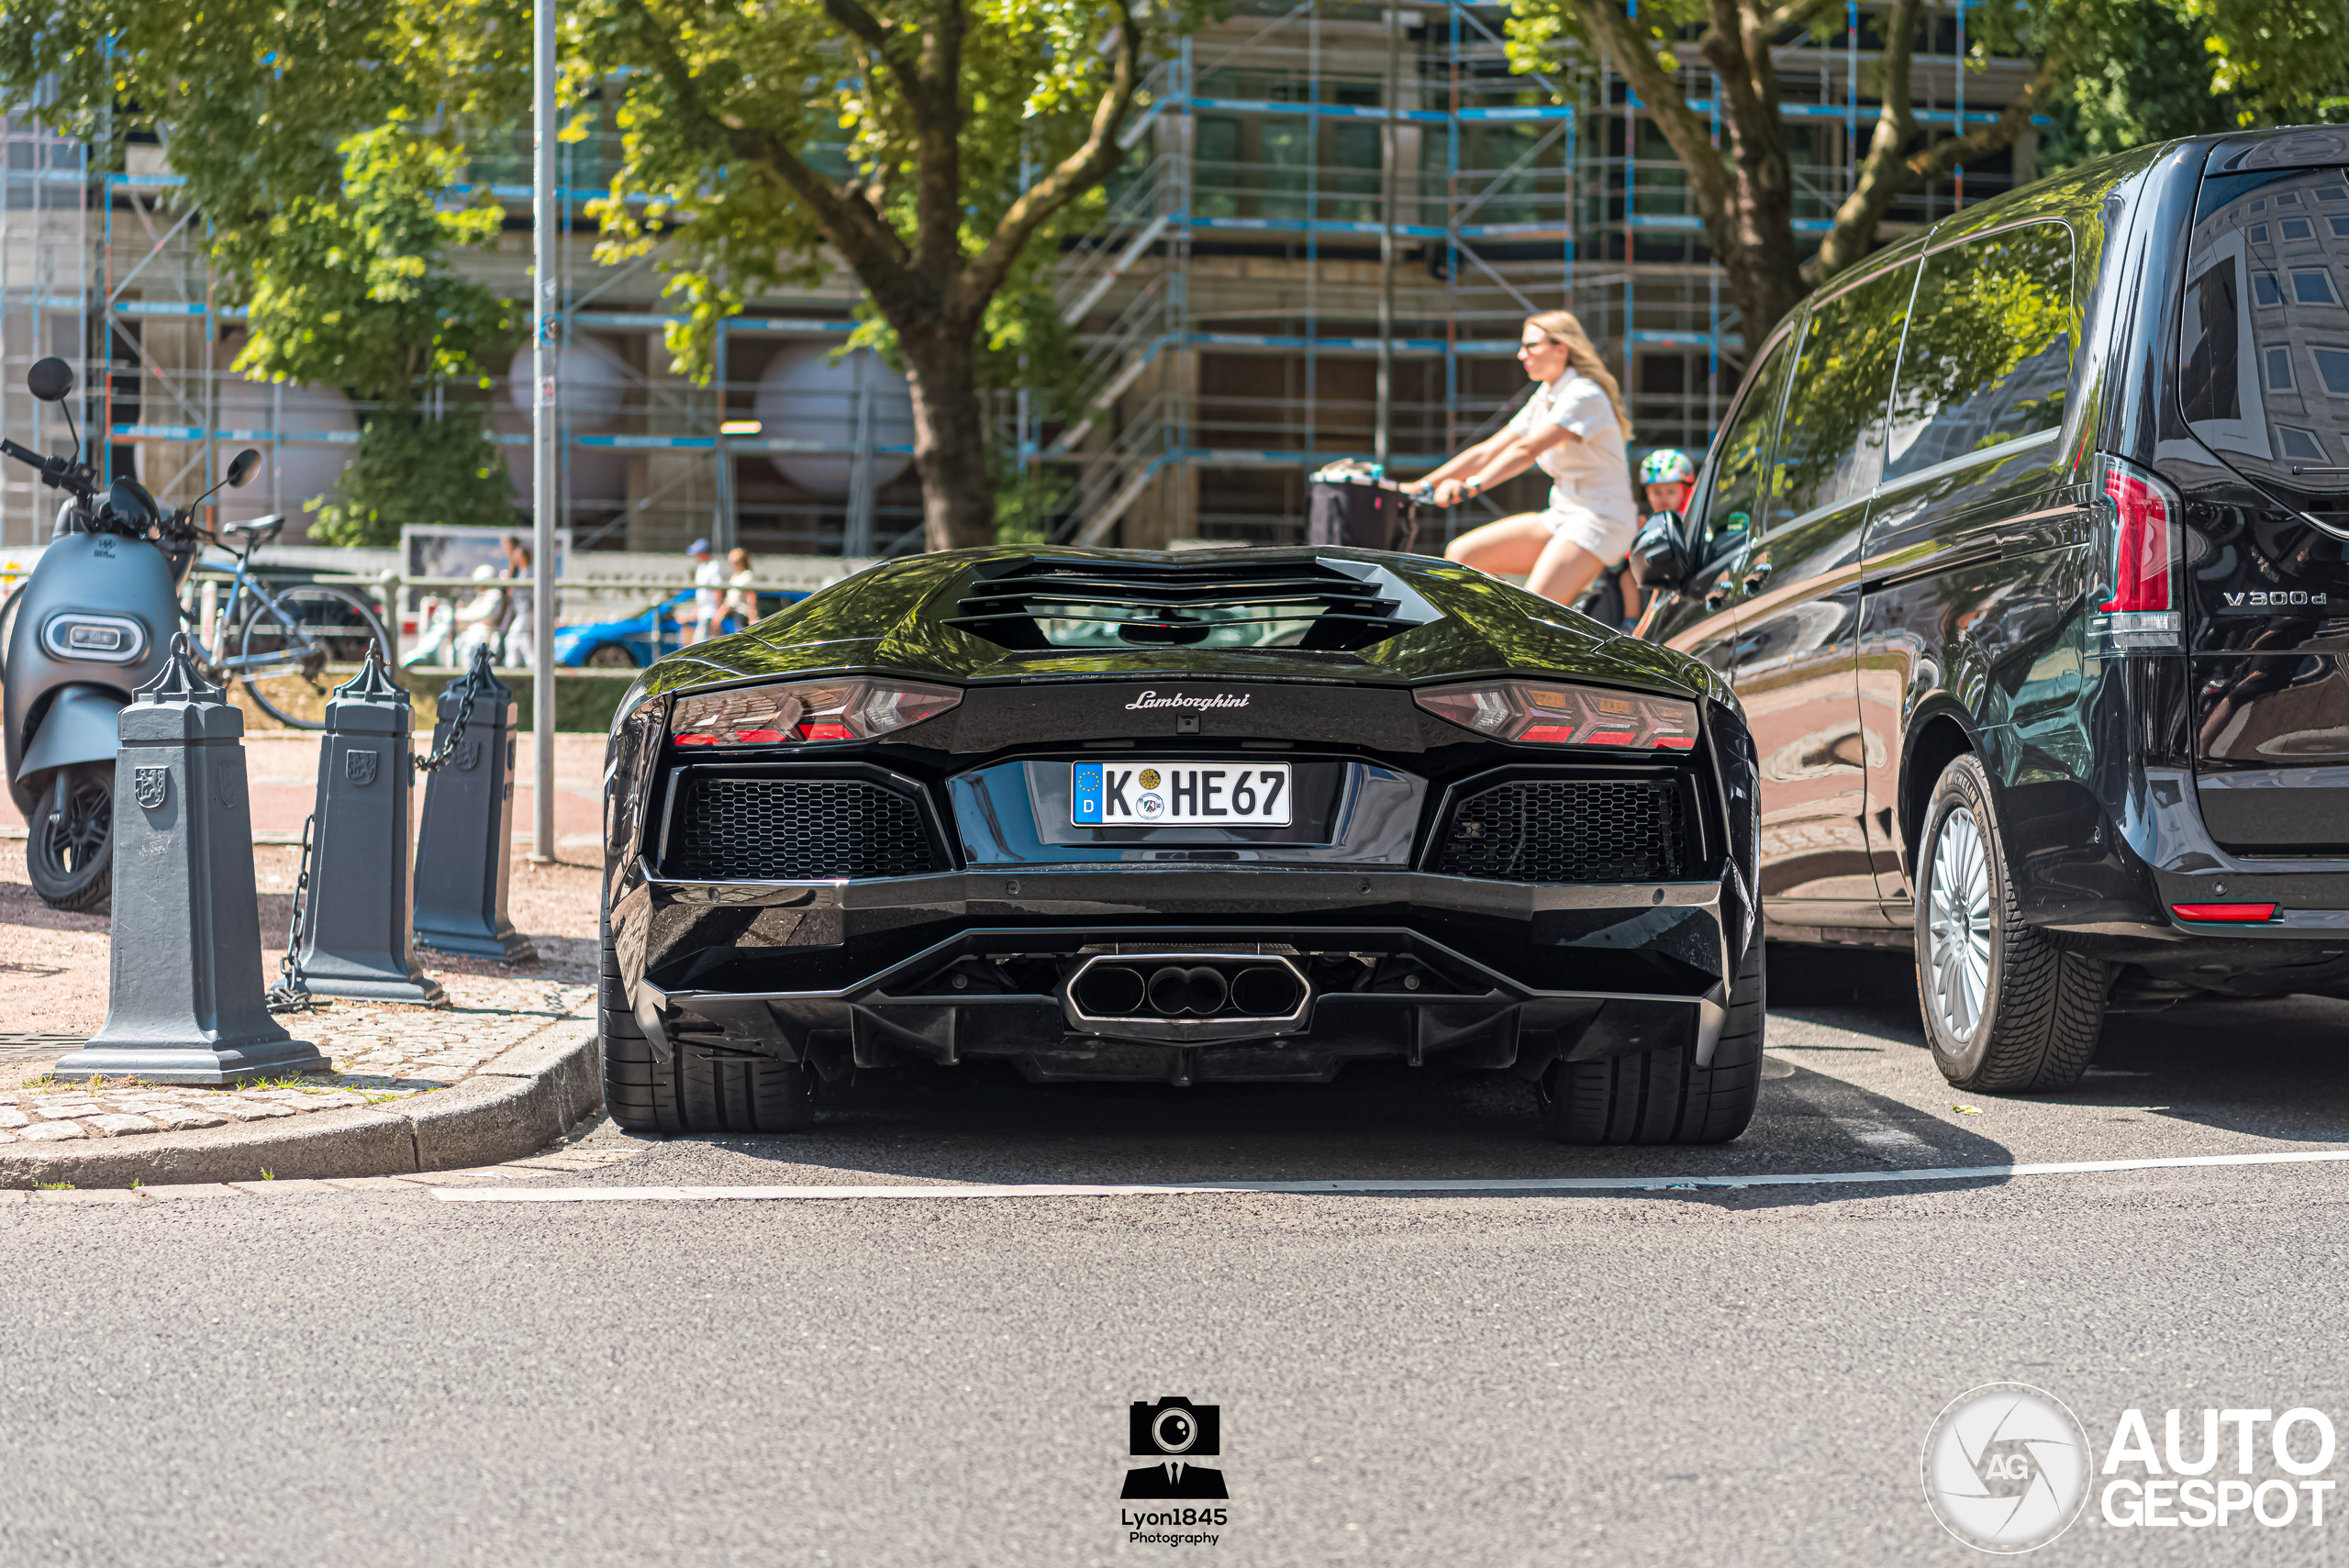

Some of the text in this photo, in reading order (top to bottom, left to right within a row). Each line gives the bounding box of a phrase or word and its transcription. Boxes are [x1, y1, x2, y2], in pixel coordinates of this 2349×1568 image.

[1125, 690, 1250, 711] Lamborghini
[1106, 771, 1286, 816] K HE67
[1946, 772, 1977, 805] MICHELIN
[1083, 799, 1095, 814] D
[1976, 810, 1987, 840] PILOT
